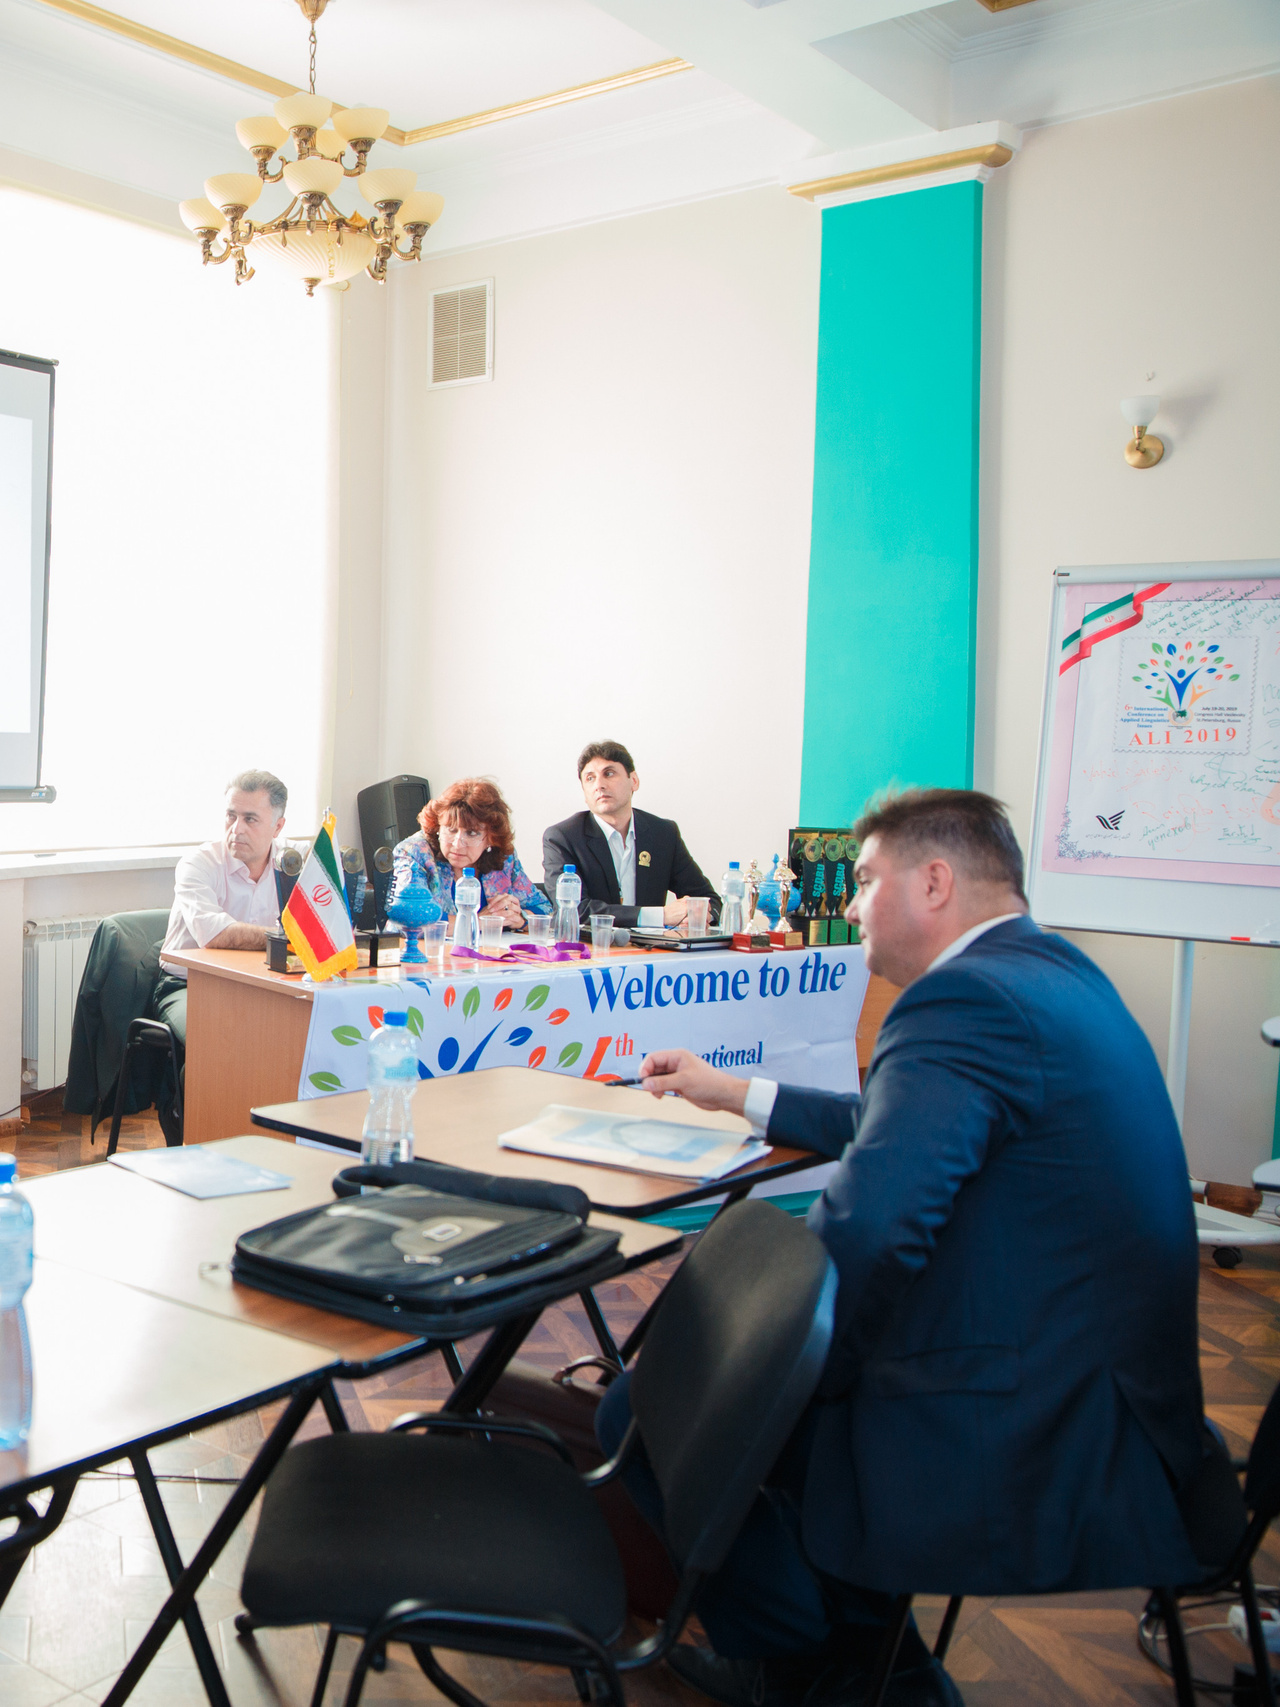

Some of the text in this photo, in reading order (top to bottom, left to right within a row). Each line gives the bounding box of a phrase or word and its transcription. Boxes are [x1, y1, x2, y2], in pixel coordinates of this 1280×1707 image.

[1128, 727, 1237, 746] ALI 2019
[578, 952, 847, 1014] Welcome to the
